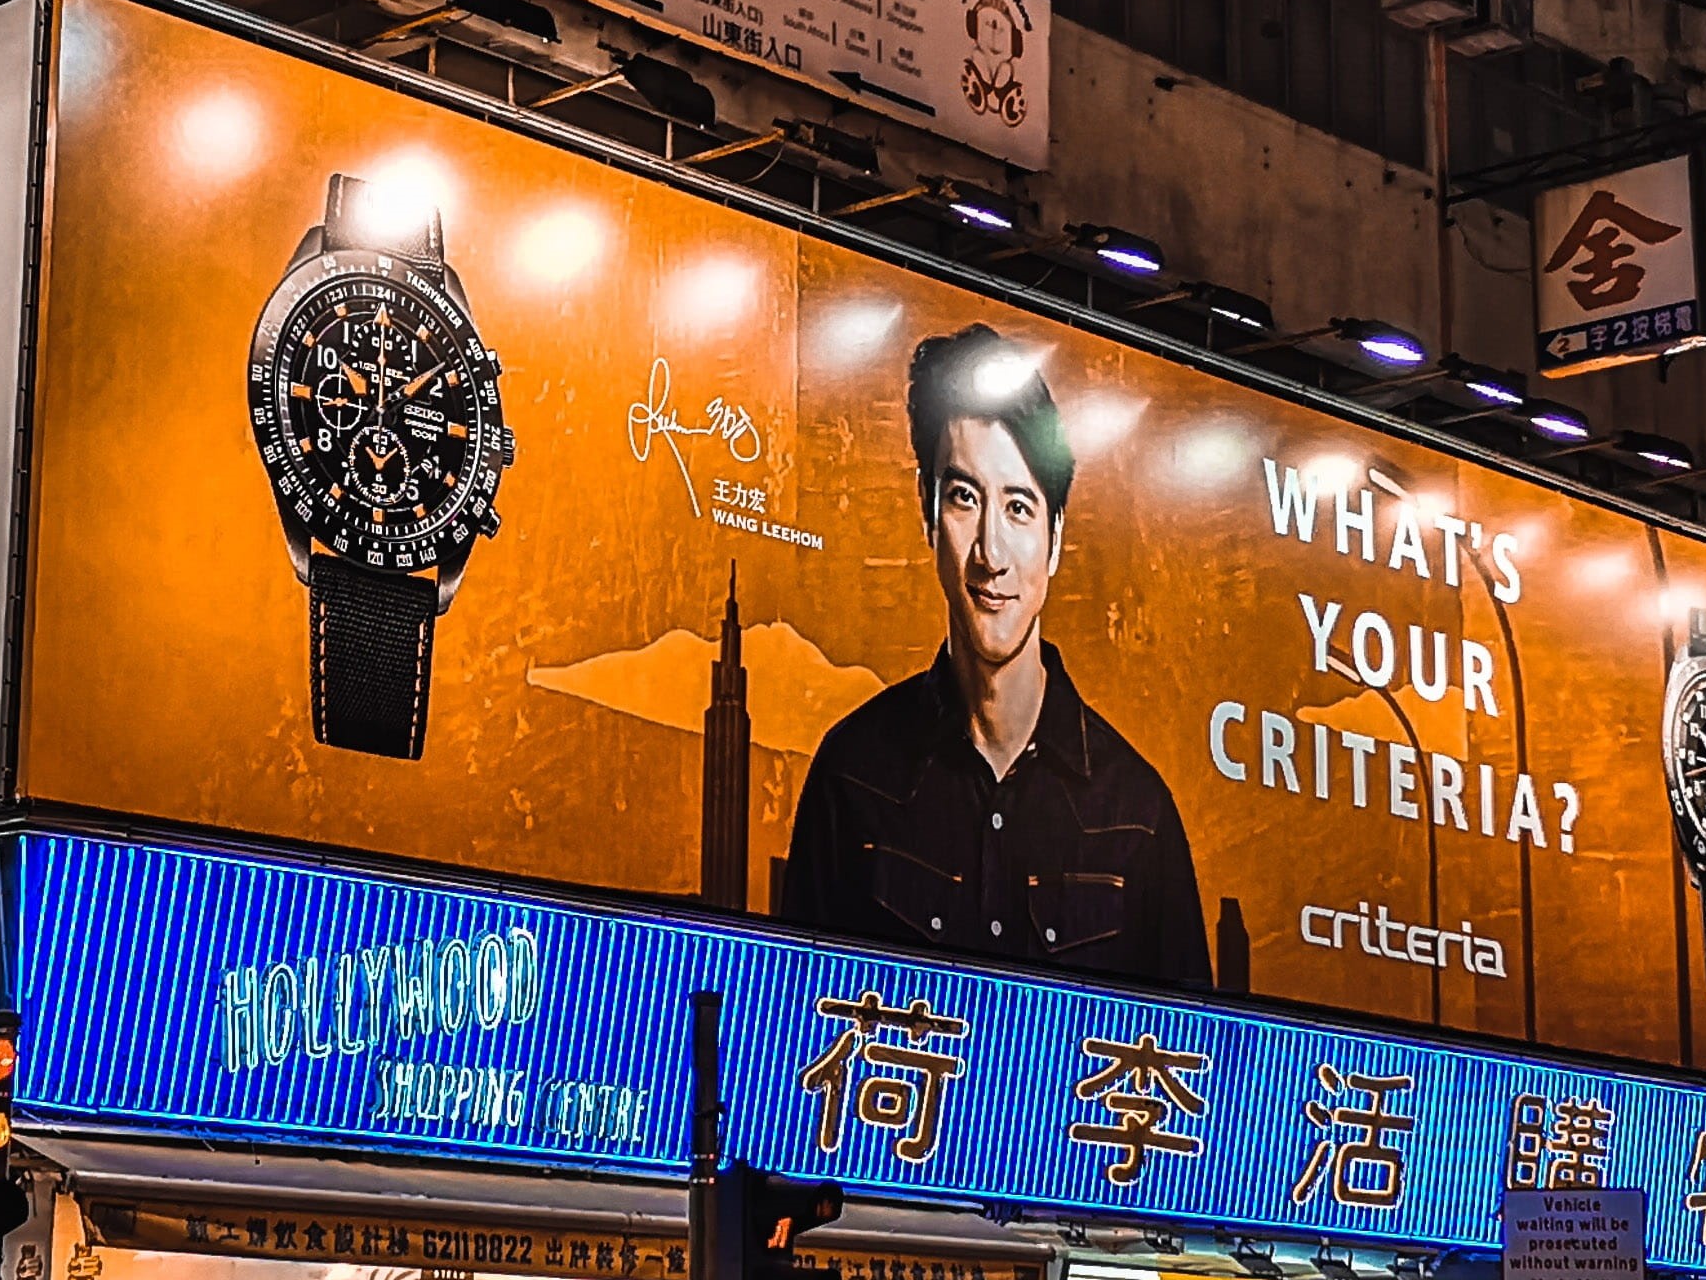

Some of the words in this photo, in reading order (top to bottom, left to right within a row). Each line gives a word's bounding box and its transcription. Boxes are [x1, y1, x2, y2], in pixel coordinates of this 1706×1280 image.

[702, 14, 802, 70] 山東街入口
[406, 271, 463, 329] TACHYMETER
[404, 404, 444, 422] SEIKO
[712, 479, 767, 514] 王力宏
[712, 509, 757, 533] WANG
[762, 522, 823, 550] LEEHOM
[1263, 457, 1522, 604] WHAT'S
[1298, 593, 1499, 719] YOUR
[1209, 700, 1580, 854] CRITERIA?
[1300, 901, 1507, 979] criteria
[223, 925, 538, 1075] HOLLYWOOD
[375, 1059, 523, 1127] SHOPPING
[538, 1081, 644, 1143] CENTRE
[1517, 1218, 1574, 1233] waiting
[1579, 1217, 1607, 1231] will
[1611, 1217, 1628, 1231] be
[1544, 1197, 1601, 1212] Vehicle
[422, 1226, 469, 1262] 6211
[1509, 1256, 1570, 1270] without
[1575, 1257, 1637, 1272] warning
[1529, 1236, 1617, 1253] prosecuted
